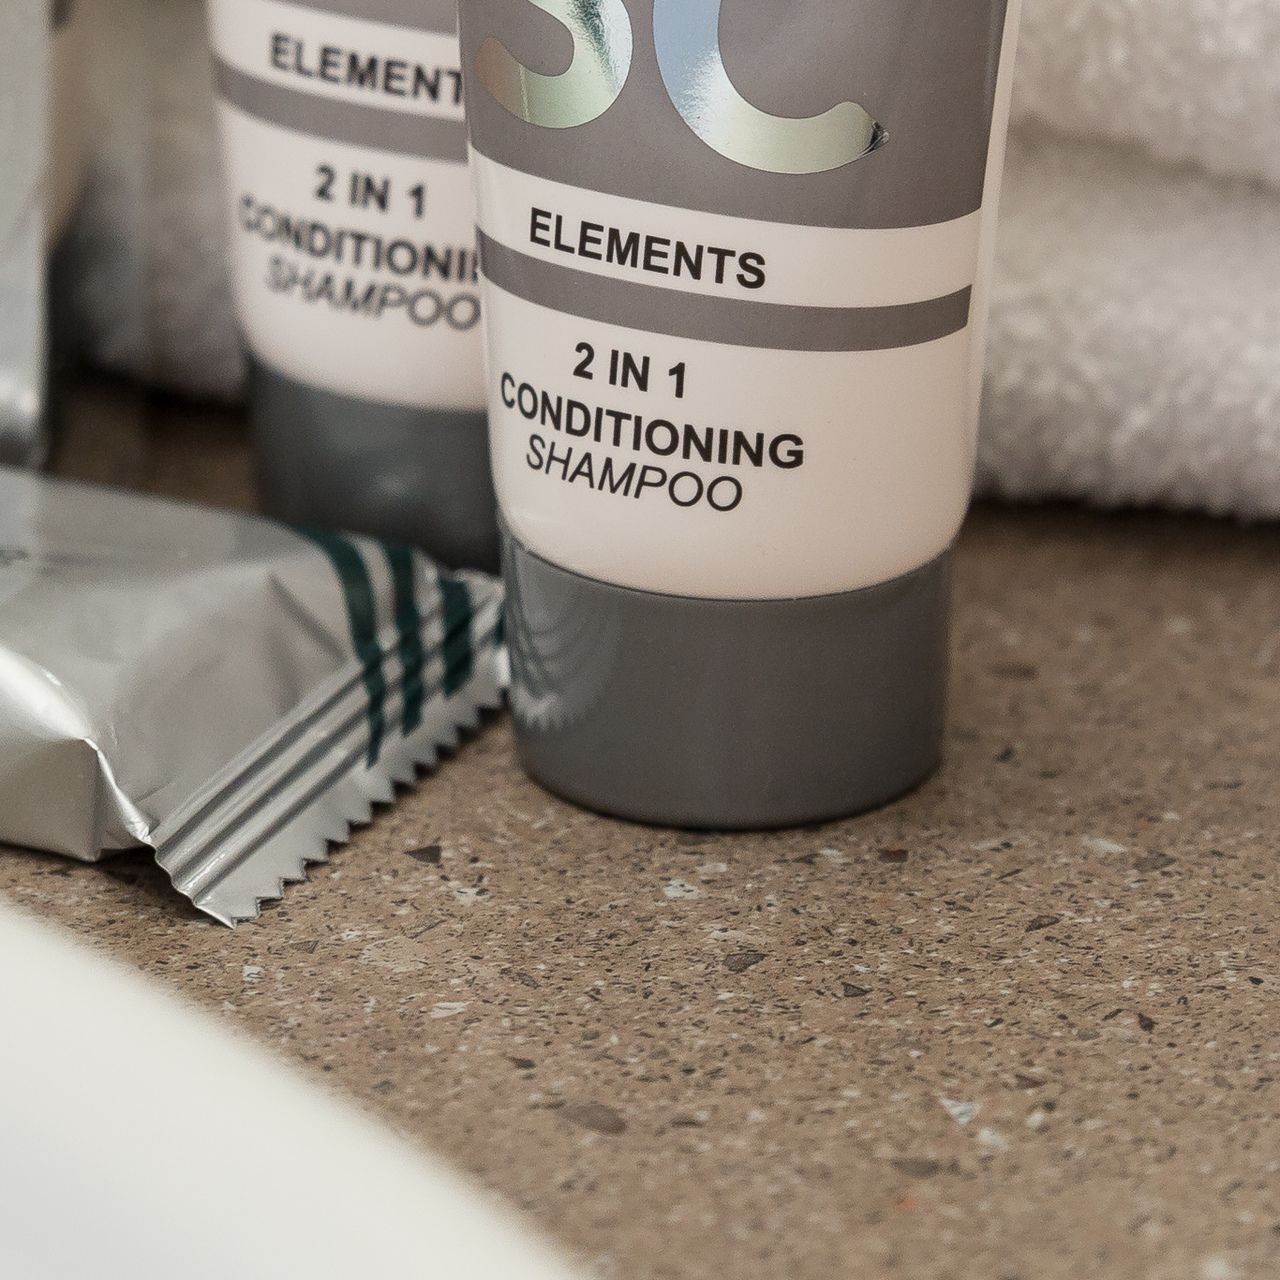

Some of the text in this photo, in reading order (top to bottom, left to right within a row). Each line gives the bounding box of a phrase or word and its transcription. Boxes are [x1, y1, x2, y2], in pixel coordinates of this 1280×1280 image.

[314, 163, 426, 219] 2 IN 1
[529, 207, 767, 289] ELEMENTS
[267, 254, 482, 332] SHAMPOO
[573, 342, 686, 399] 2 IN 1
[500, 371, 805, 469] CONDITIONING
[525, 433, 744, 513] SHAMPOO
